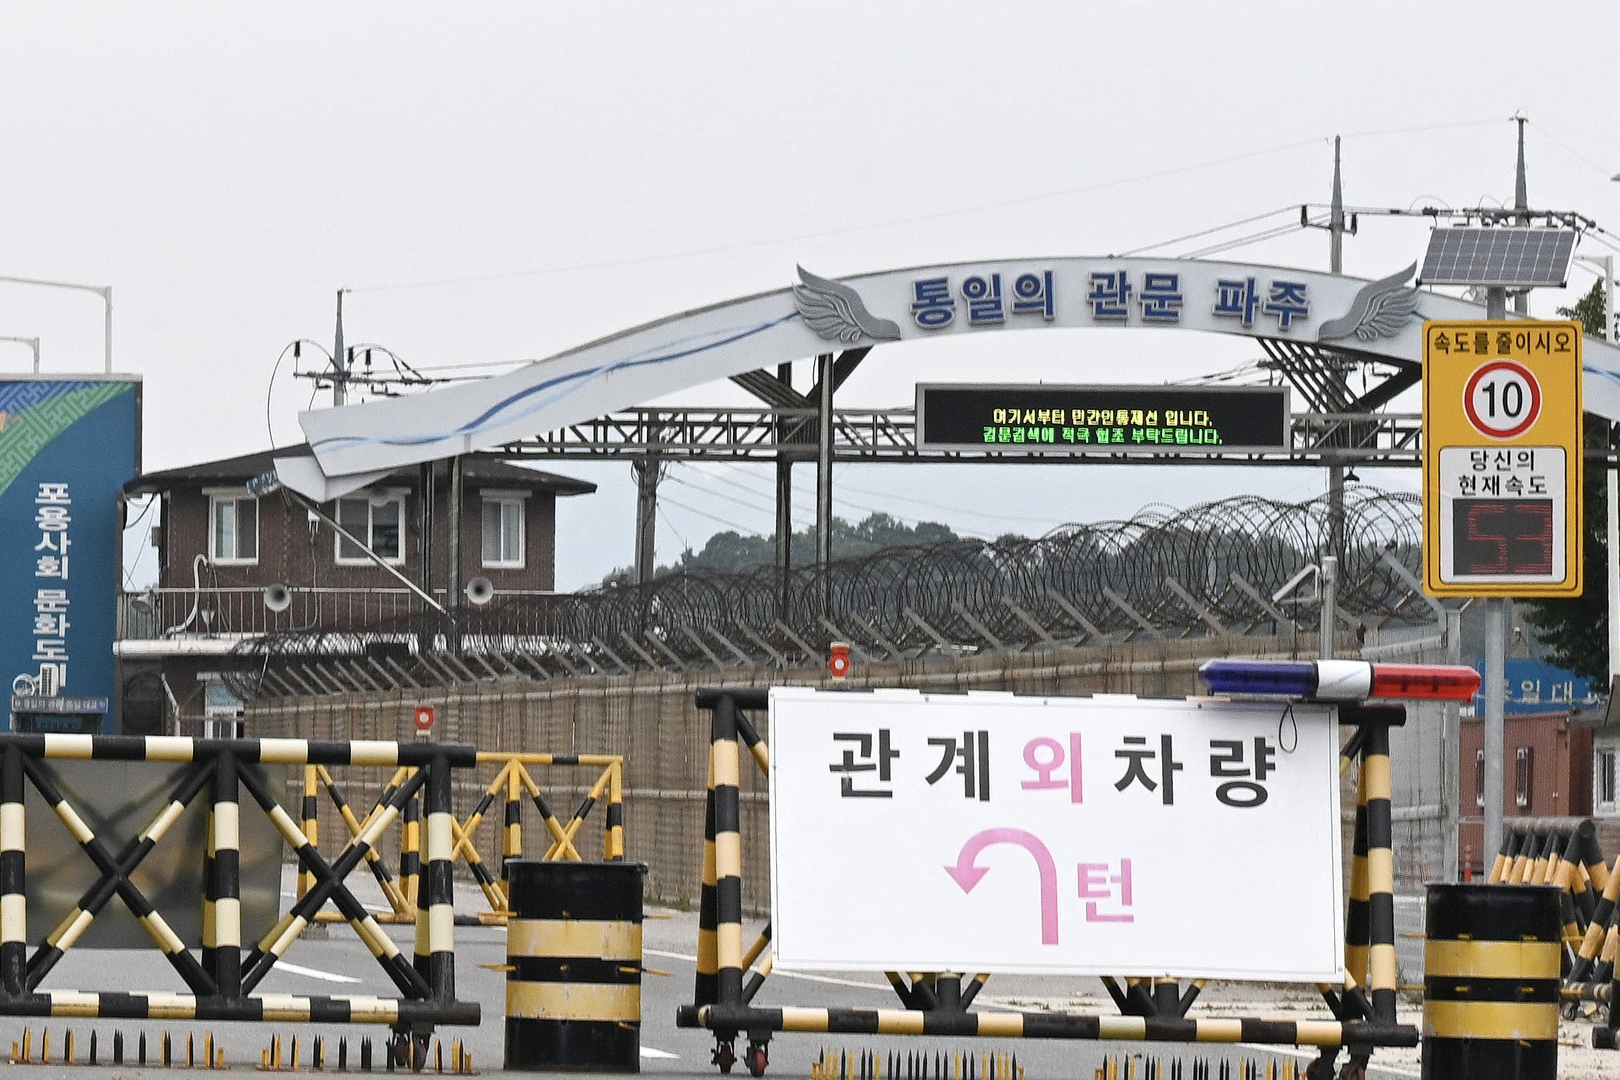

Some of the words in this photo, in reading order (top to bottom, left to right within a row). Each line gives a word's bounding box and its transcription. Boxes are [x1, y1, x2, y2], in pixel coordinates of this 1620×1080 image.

[910, 270, 1057, 329] 통일의
[1087, 270, 1183, 322] 관문
[1211, 276, 1310, 331] 파주
[1434, 331, 1489, 355] 속도를
[1495, 331, 1571, 355] 줄이시오
[1482, 381, 1524, 418] 10
[1470, 450, 1535, 472] 당신의
[1459, 475, 1547, 496] 현재속도
[34, 482, 71, 580] 포용사회
[1077, 858, 1134, 922] 턴
